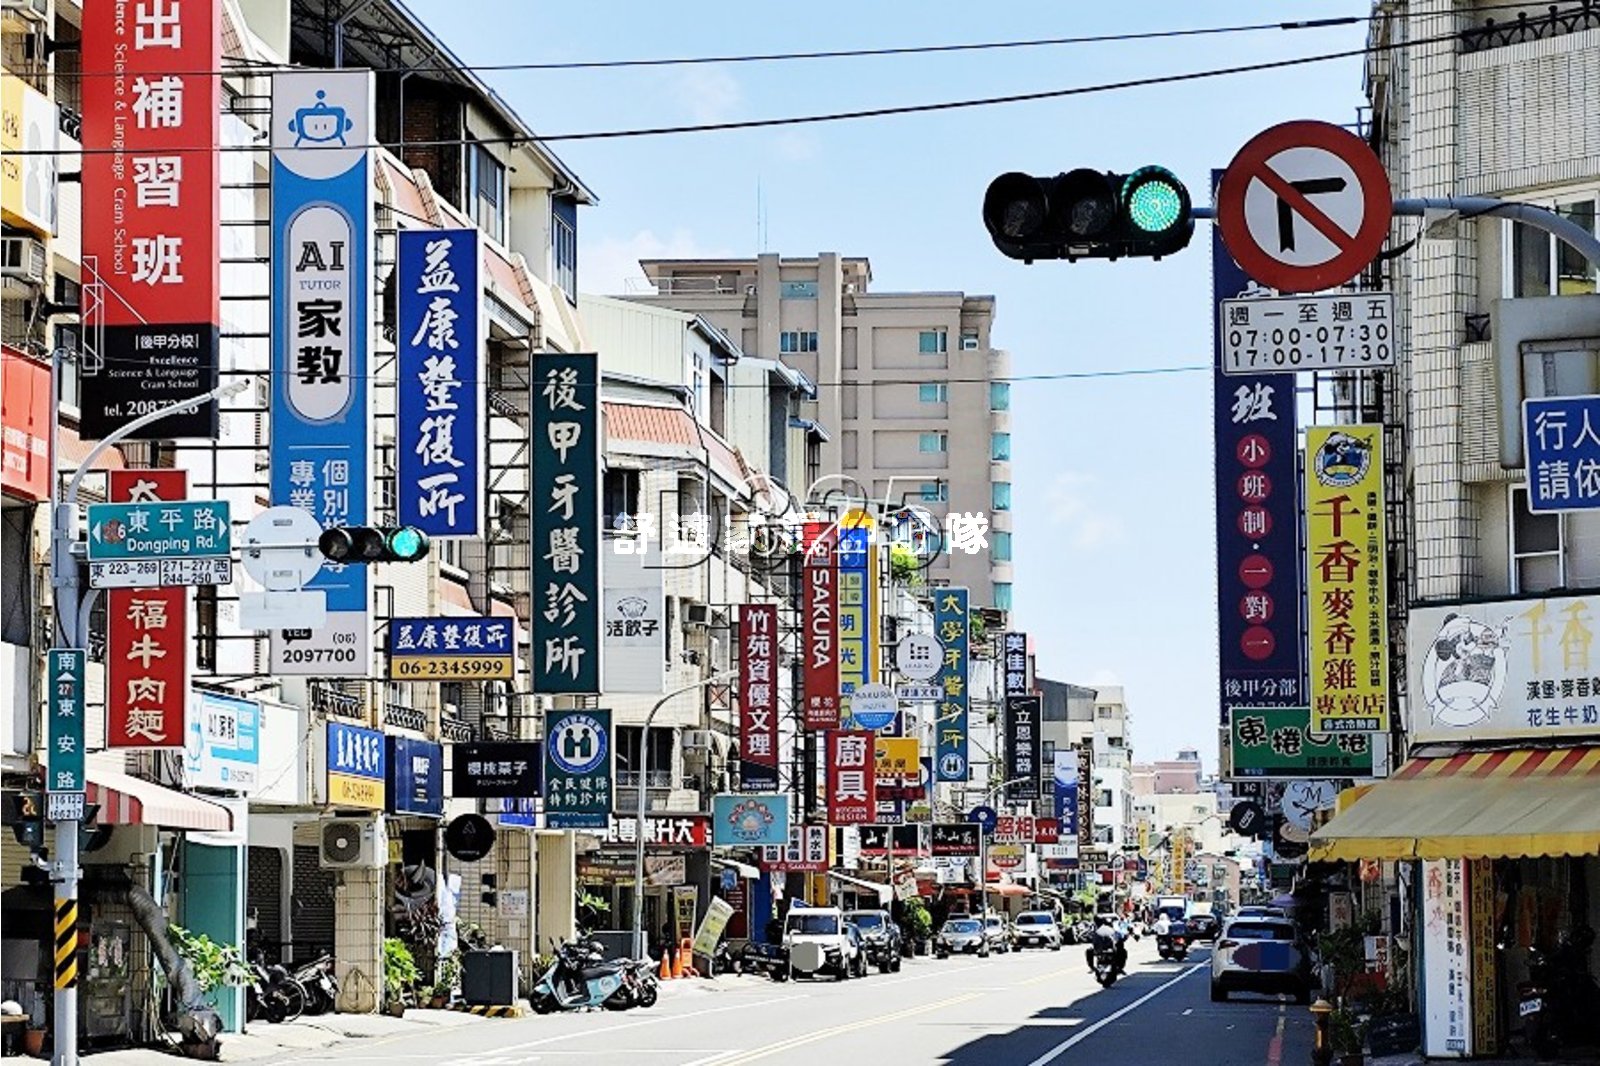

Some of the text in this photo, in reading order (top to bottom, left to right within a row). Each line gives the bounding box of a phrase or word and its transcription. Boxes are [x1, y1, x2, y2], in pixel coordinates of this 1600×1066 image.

[114, 43, 128, 96] Science
[112, 117, 126, 180] Language
[114, 189, 127, 225] Cram
[114, 229, 127, 275] School
[296, 241, 344, 272] AI
[299, 280, 341, 290] TUTOR
[1229, 300, 1388, 328] 週一至週五
[140, 334, 194, 349] 後甲分校
[297, 298, 342, 384] 家教
[1229, 323, 1389, 348] 07:00-07:30
[1232, 344, 1390, 367] 17:00-17:30
[108, 369, 143, 378] Science
[154, 368, 199, 379] Language
[140, 379, 199, 389] Cram School
[411, 238, 466, 527] 益康整復所
[104, 403, 123, 416] tel.
[1535, 408, 1600, 451] 行人
[127, 507, 217, 533] 東平路
[542, 367, 588, 681] 後甲牙醫診所
[127, 535, 217, 553] Dongping Rd.
[162, 560, 212, 573] 271-277
[1312, 494, 1362, 691] 千香麥香雞
[606, 619, 660, 638] 活飲子
[812, 569, 832, 669] SAKURA
[395, 623, 509, 650] 益康整復所
[57, 652, 77, 671] 南
[282, 649, 355, 663] 2097700
[399, 658, 504, 676] 06-2345999
[746, 608, 772, 757] 竹苑資優文理
[939, 594, 964, 749] 大學牙醫診所
[1224, 679, 1298, 698] 後甲分部
[1315, 694, 1386, 716] 專賣店
[1526, 704, 1598, 727] 花生牛奶
[57, 698, 77, 789] 東安路
[1014, 708, 1033, 774] 立恩樂器
[1237, 716, 1369, 757] 東捲捲
[835, 735, 868, 803] 廚具
[548, 776, 608, 792] 全民健保
[548, 791, 608, 807] 特約診所
[995, 816, 1034, 841] 照相
